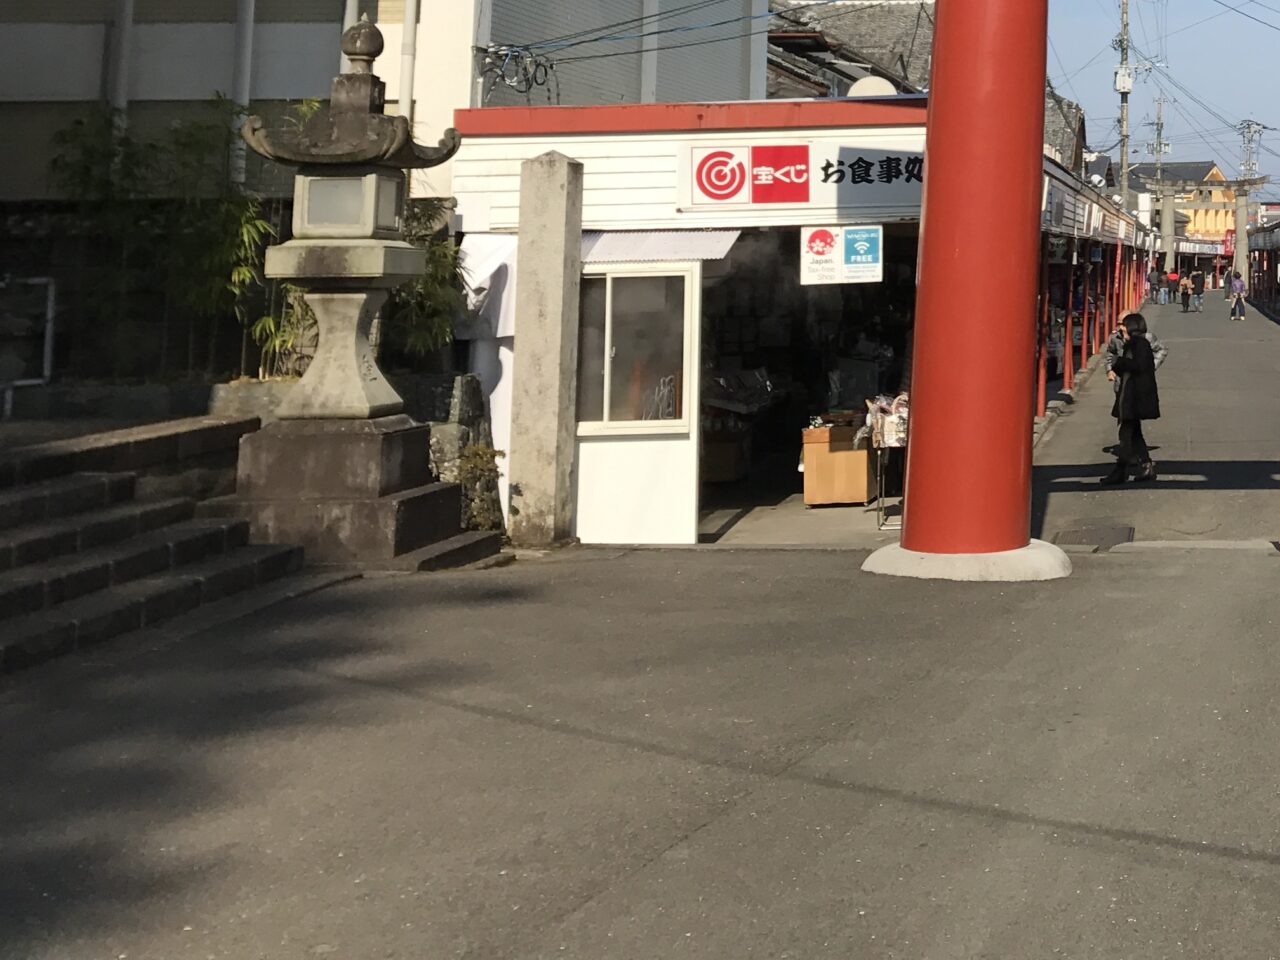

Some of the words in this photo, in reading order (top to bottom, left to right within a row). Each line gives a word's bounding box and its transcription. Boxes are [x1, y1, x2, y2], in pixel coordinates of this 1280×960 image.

[752, 164, 809, 185] 宝くじ
[850, 254, 873, 263] FREE
